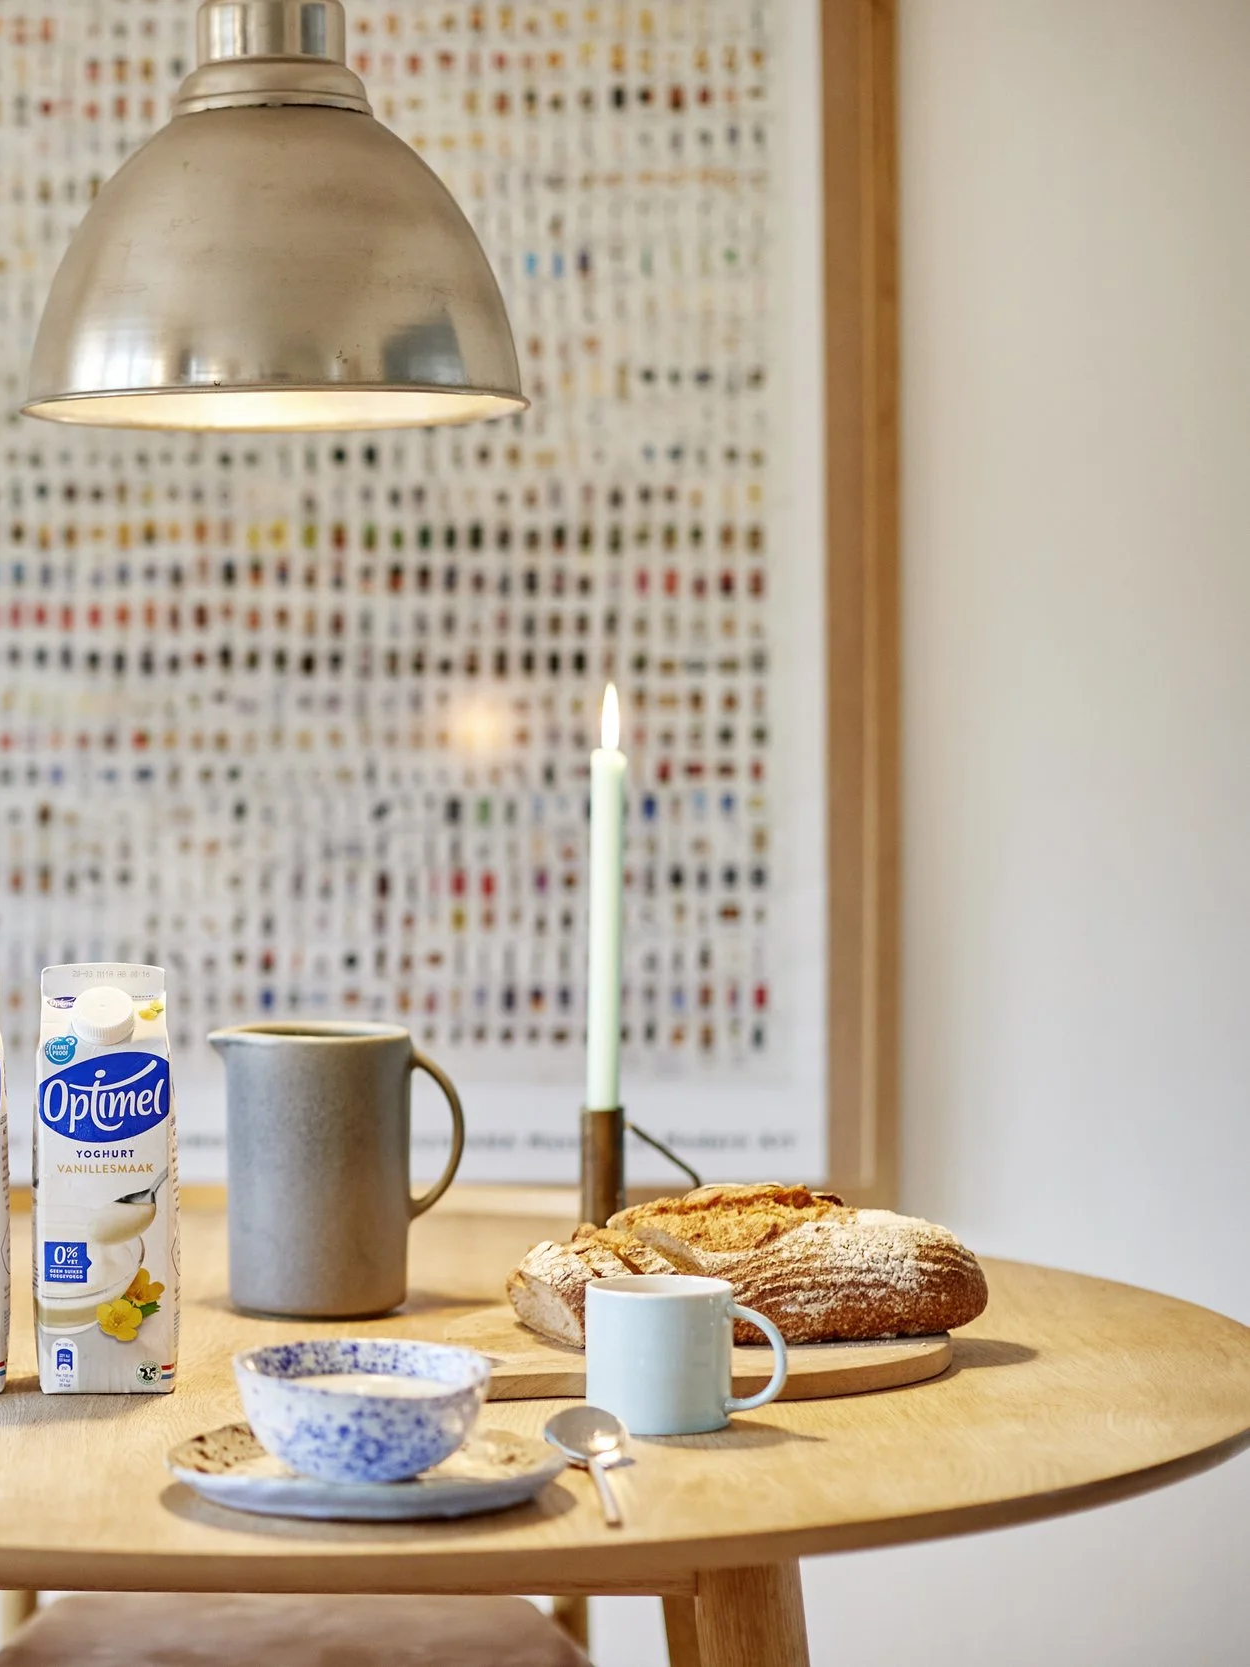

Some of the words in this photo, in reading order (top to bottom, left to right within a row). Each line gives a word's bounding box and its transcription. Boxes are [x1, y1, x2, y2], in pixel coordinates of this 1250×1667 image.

[43, 1060, 165, 1133] Optimel
[76, 1149, 135, 1158] YOGHURT
[57, 1163, 154, 1173] VANILLESMAAK
[54, 1246, 78, 1264] 0%
